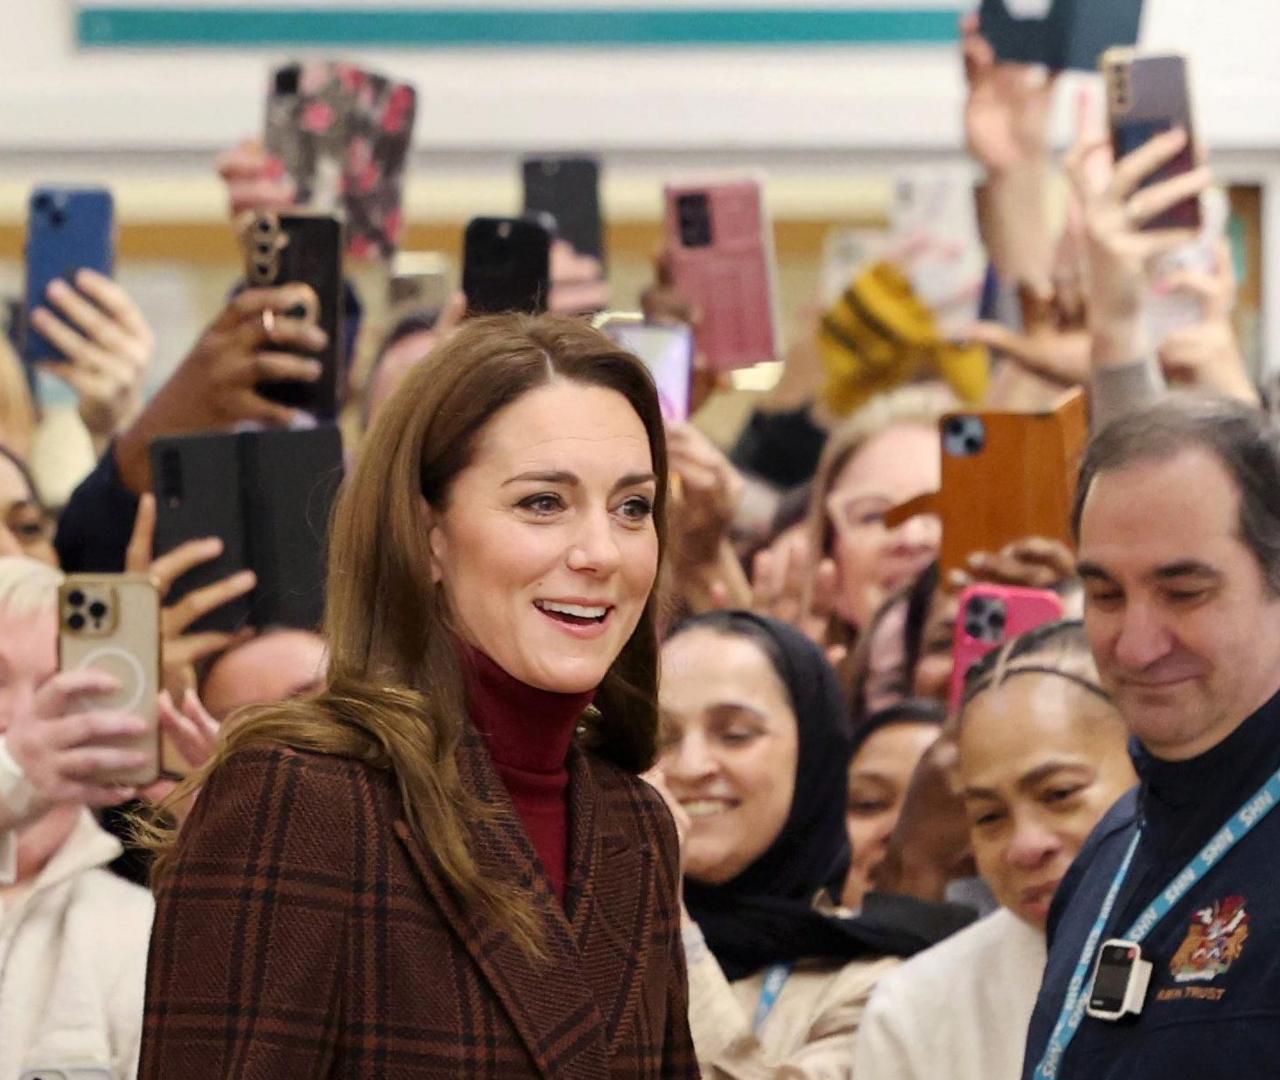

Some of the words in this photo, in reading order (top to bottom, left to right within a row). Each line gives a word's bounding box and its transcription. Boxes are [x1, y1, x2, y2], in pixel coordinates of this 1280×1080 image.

[1238, 790, 1273, 828] NHS
[1201, 827, 1234, 866] NHS
[1164, 867, 1196, 905] NHS
